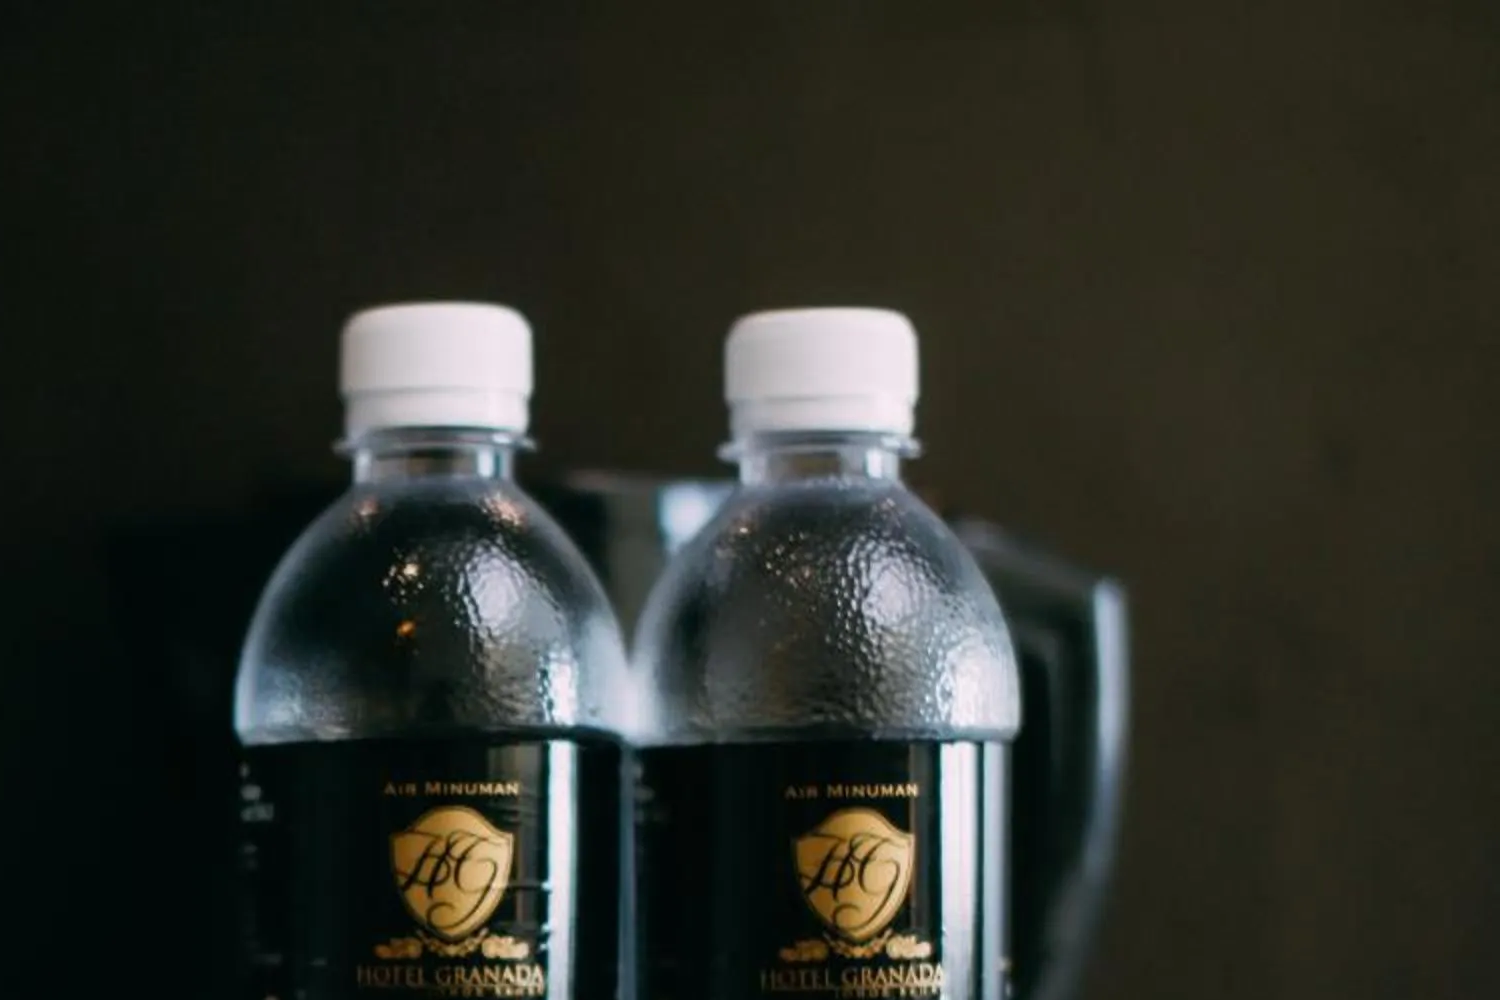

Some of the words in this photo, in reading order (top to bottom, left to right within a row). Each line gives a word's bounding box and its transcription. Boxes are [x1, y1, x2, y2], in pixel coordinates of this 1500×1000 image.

[424, 781, 520, 796] MINUMAN
[827, 783, 919, 798] MINUMAN
[356, 964, 425, 988] HOTEL
[435, 963, 544, 987] GRANADA
[760, 966, 834, 990] HOTEL
[841, 963, 946, 987] GRANADA
